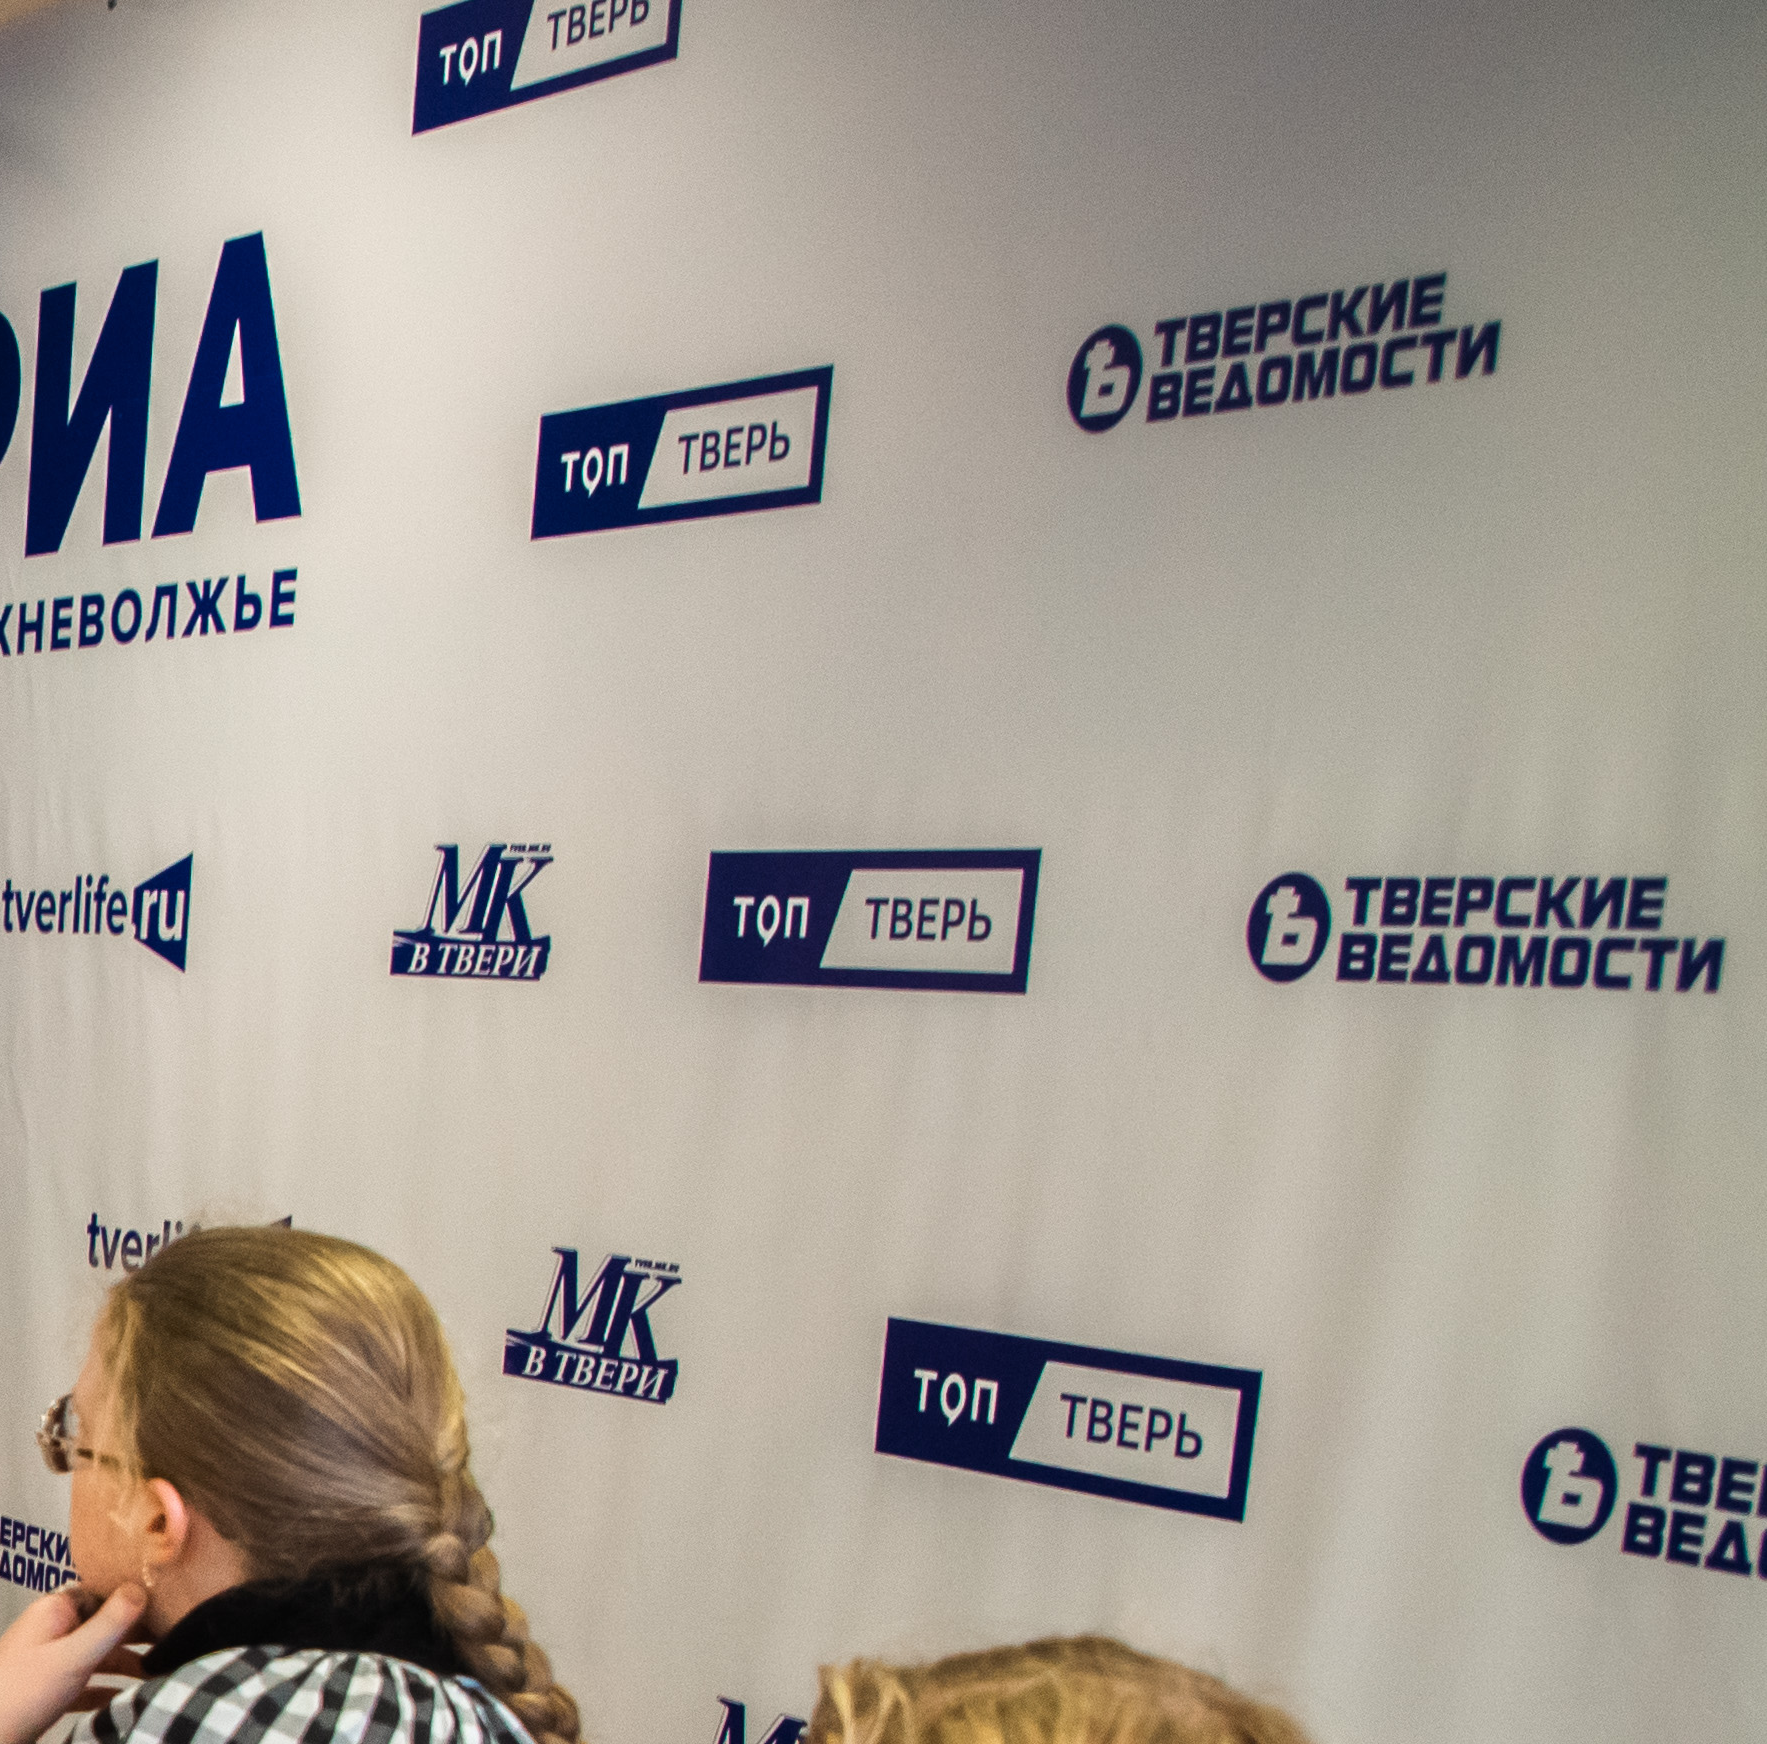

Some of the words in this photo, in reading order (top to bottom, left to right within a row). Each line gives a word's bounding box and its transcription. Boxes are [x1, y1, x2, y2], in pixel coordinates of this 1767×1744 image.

[439, 28, 501, 89] ТОП
[1152, 271, 1448, 368] ТВЕРСКИЕ
[1146, 320, 1502, 423] ВЕДОМОСТИ
[560, 443, 629, 497] ТОП
[678, 421, 790, 476] ТВЕРЬ
[420, 843, 555, 942] МК
[733, 895, 810, 947] ТОП
[865, 897, 993, 942] ТВЕРЬ
[1344, 876, 1669, 931] ТВЕРСКИЕ
[407, 943, 431, 974] В
[436, 943, 543, 978] ТВЕРИ
[1336, 933, 1726, 994] ВЕДОМОСТИ
[531, 1246, 683, 1362] МК
[521, 1346, 547, 1377] В
[553, 1350, 669, 1400] ТВЕРИ
[913, 1367, 1000, 1427] ТОП
[1060, 1391, 1204, 1461] ТВЕРЬ
[1632, 1440, 1767, 1522] ТВЕ
[1620, 1501, 1767, 1582] ВЕД
